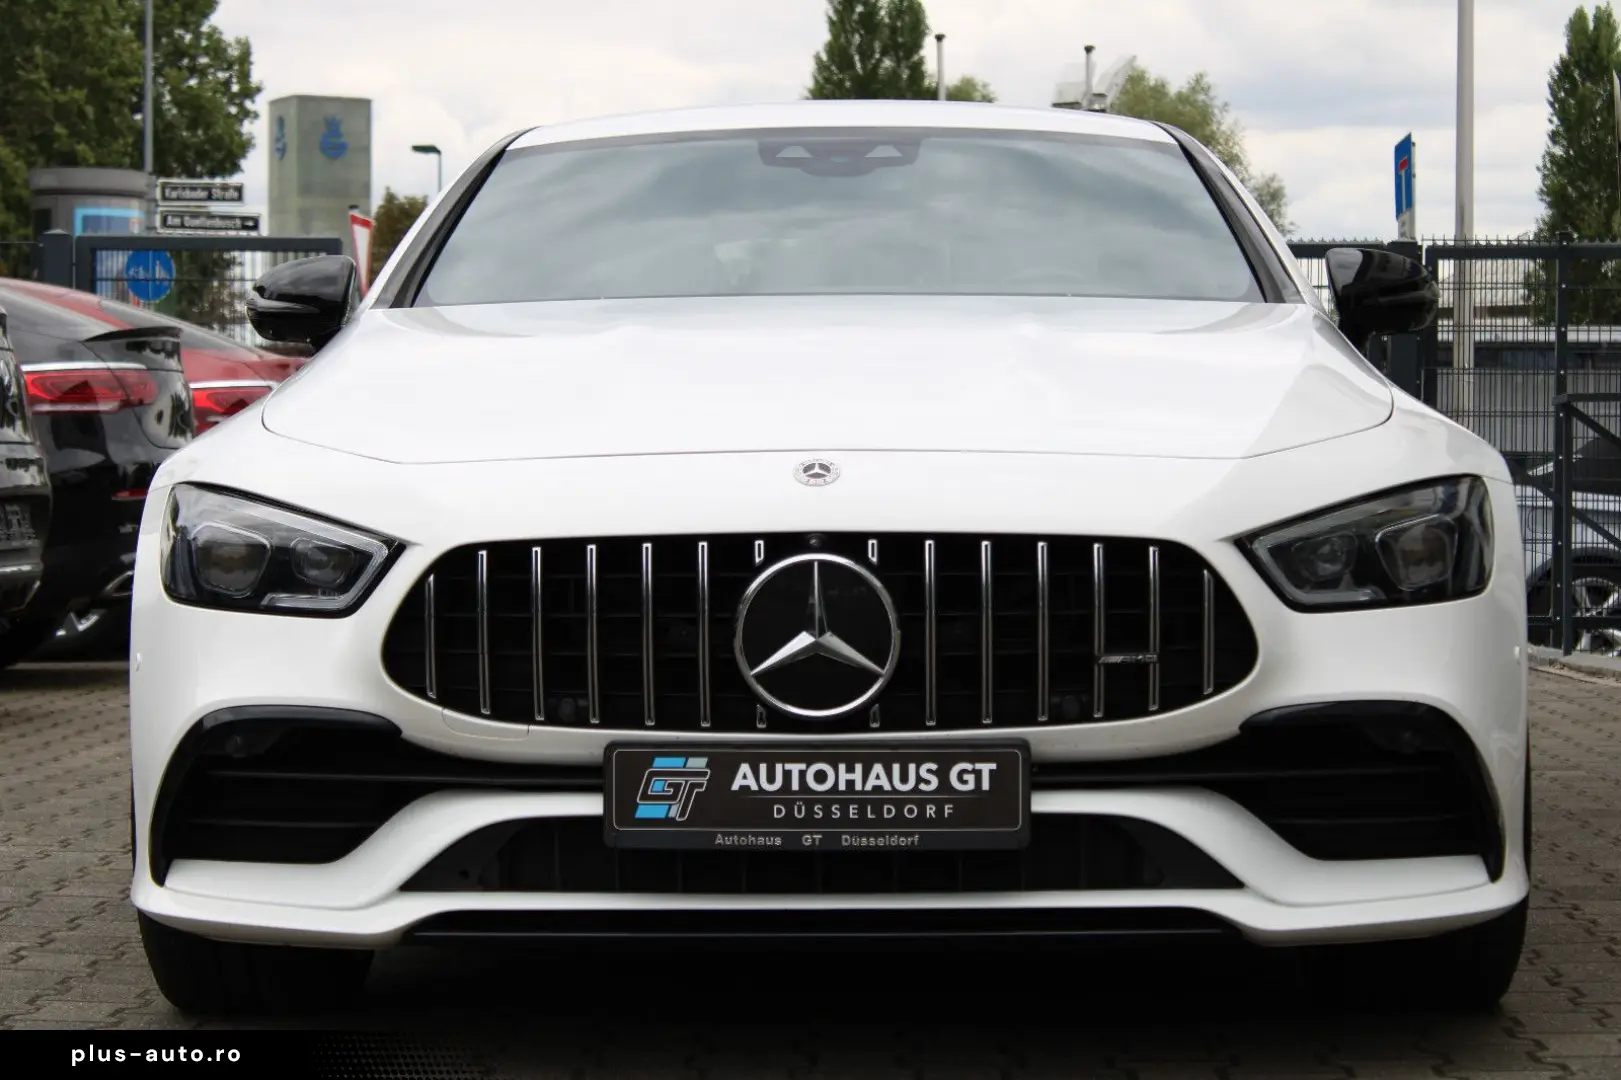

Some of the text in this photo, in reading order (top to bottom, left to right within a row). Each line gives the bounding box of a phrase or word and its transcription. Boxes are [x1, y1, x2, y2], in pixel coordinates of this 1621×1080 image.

[731, 762, 997, 792] AUTOHAUS GT
[773, 801, 954, 819] DÜSSELDORF
[714, 834, 920, 847] Autohaus GT Düsseldorf
